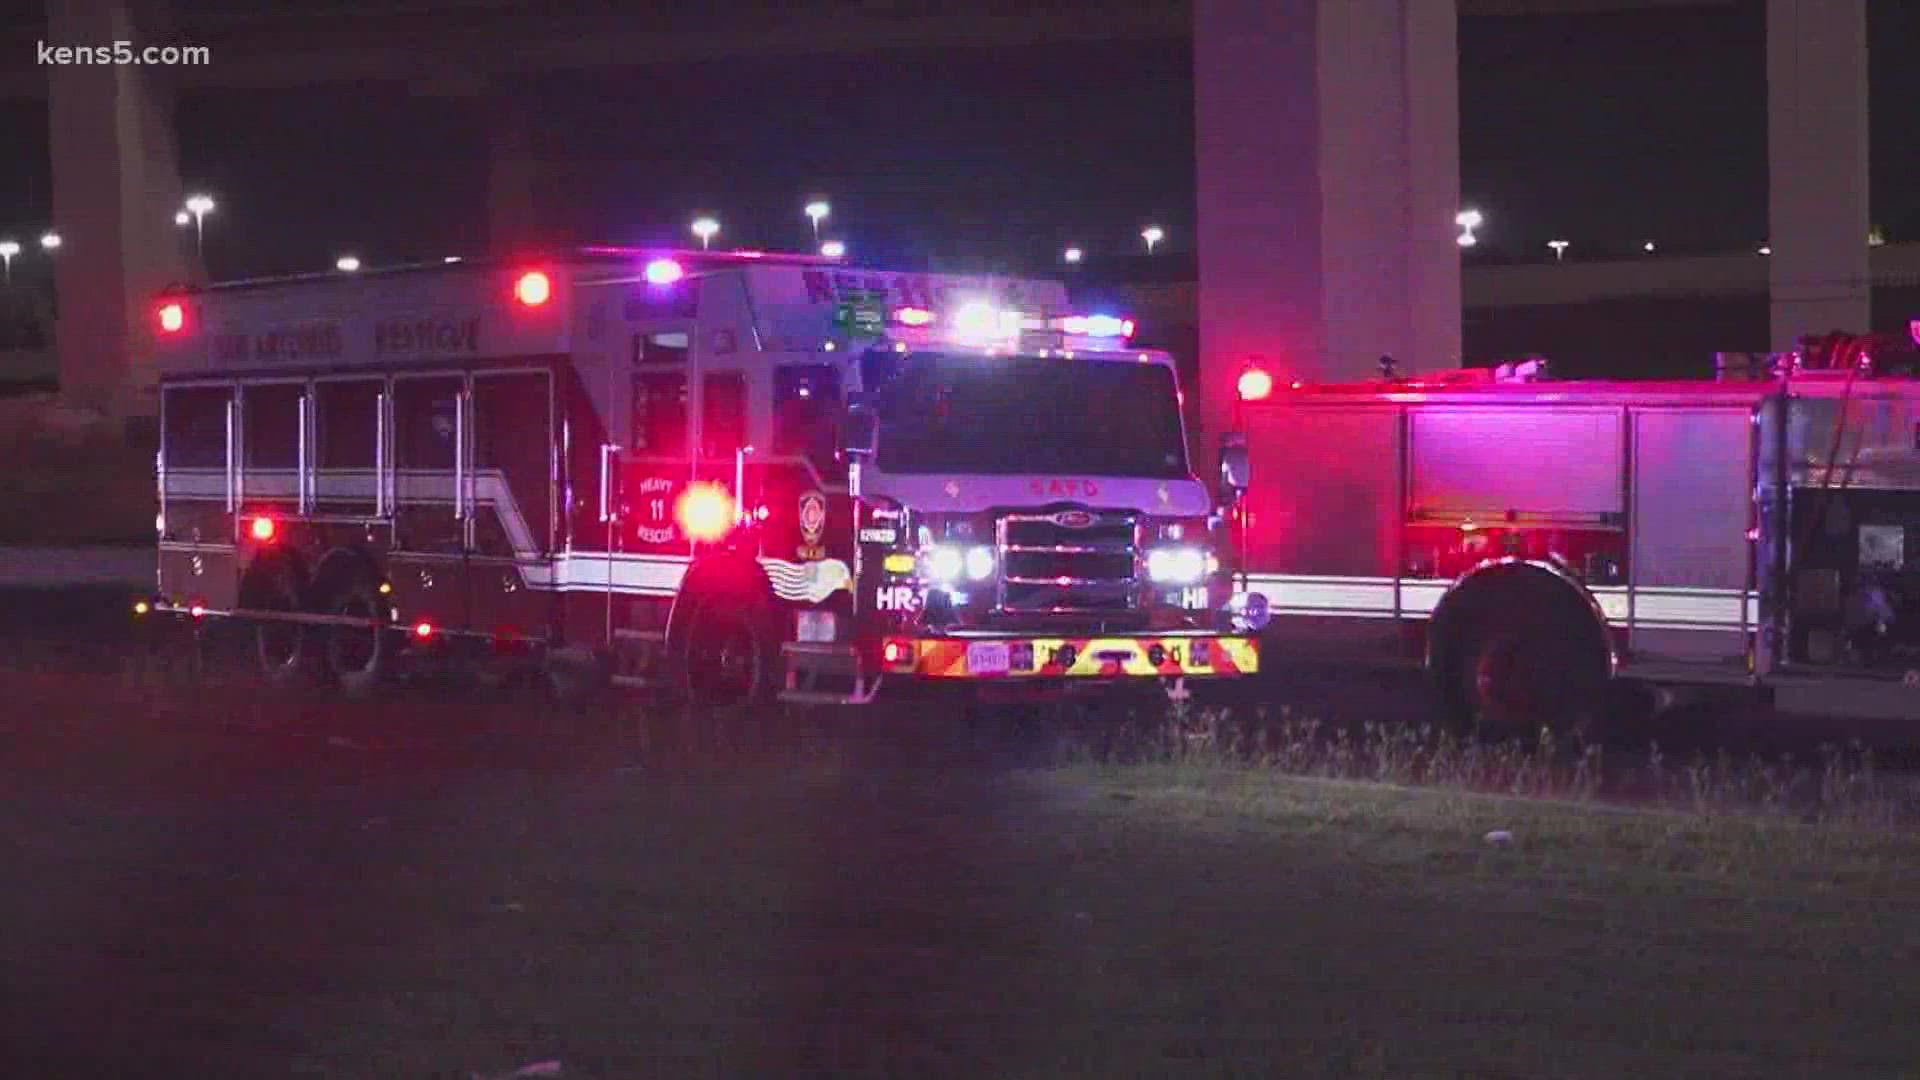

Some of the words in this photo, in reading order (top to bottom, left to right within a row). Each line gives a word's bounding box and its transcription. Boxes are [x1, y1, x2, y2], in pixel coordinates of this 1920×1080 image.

[640, 477, 672, 495] HEAVY
[651, 499, 664, 521] 11
[638, 524, 673, 543] RESCUE
